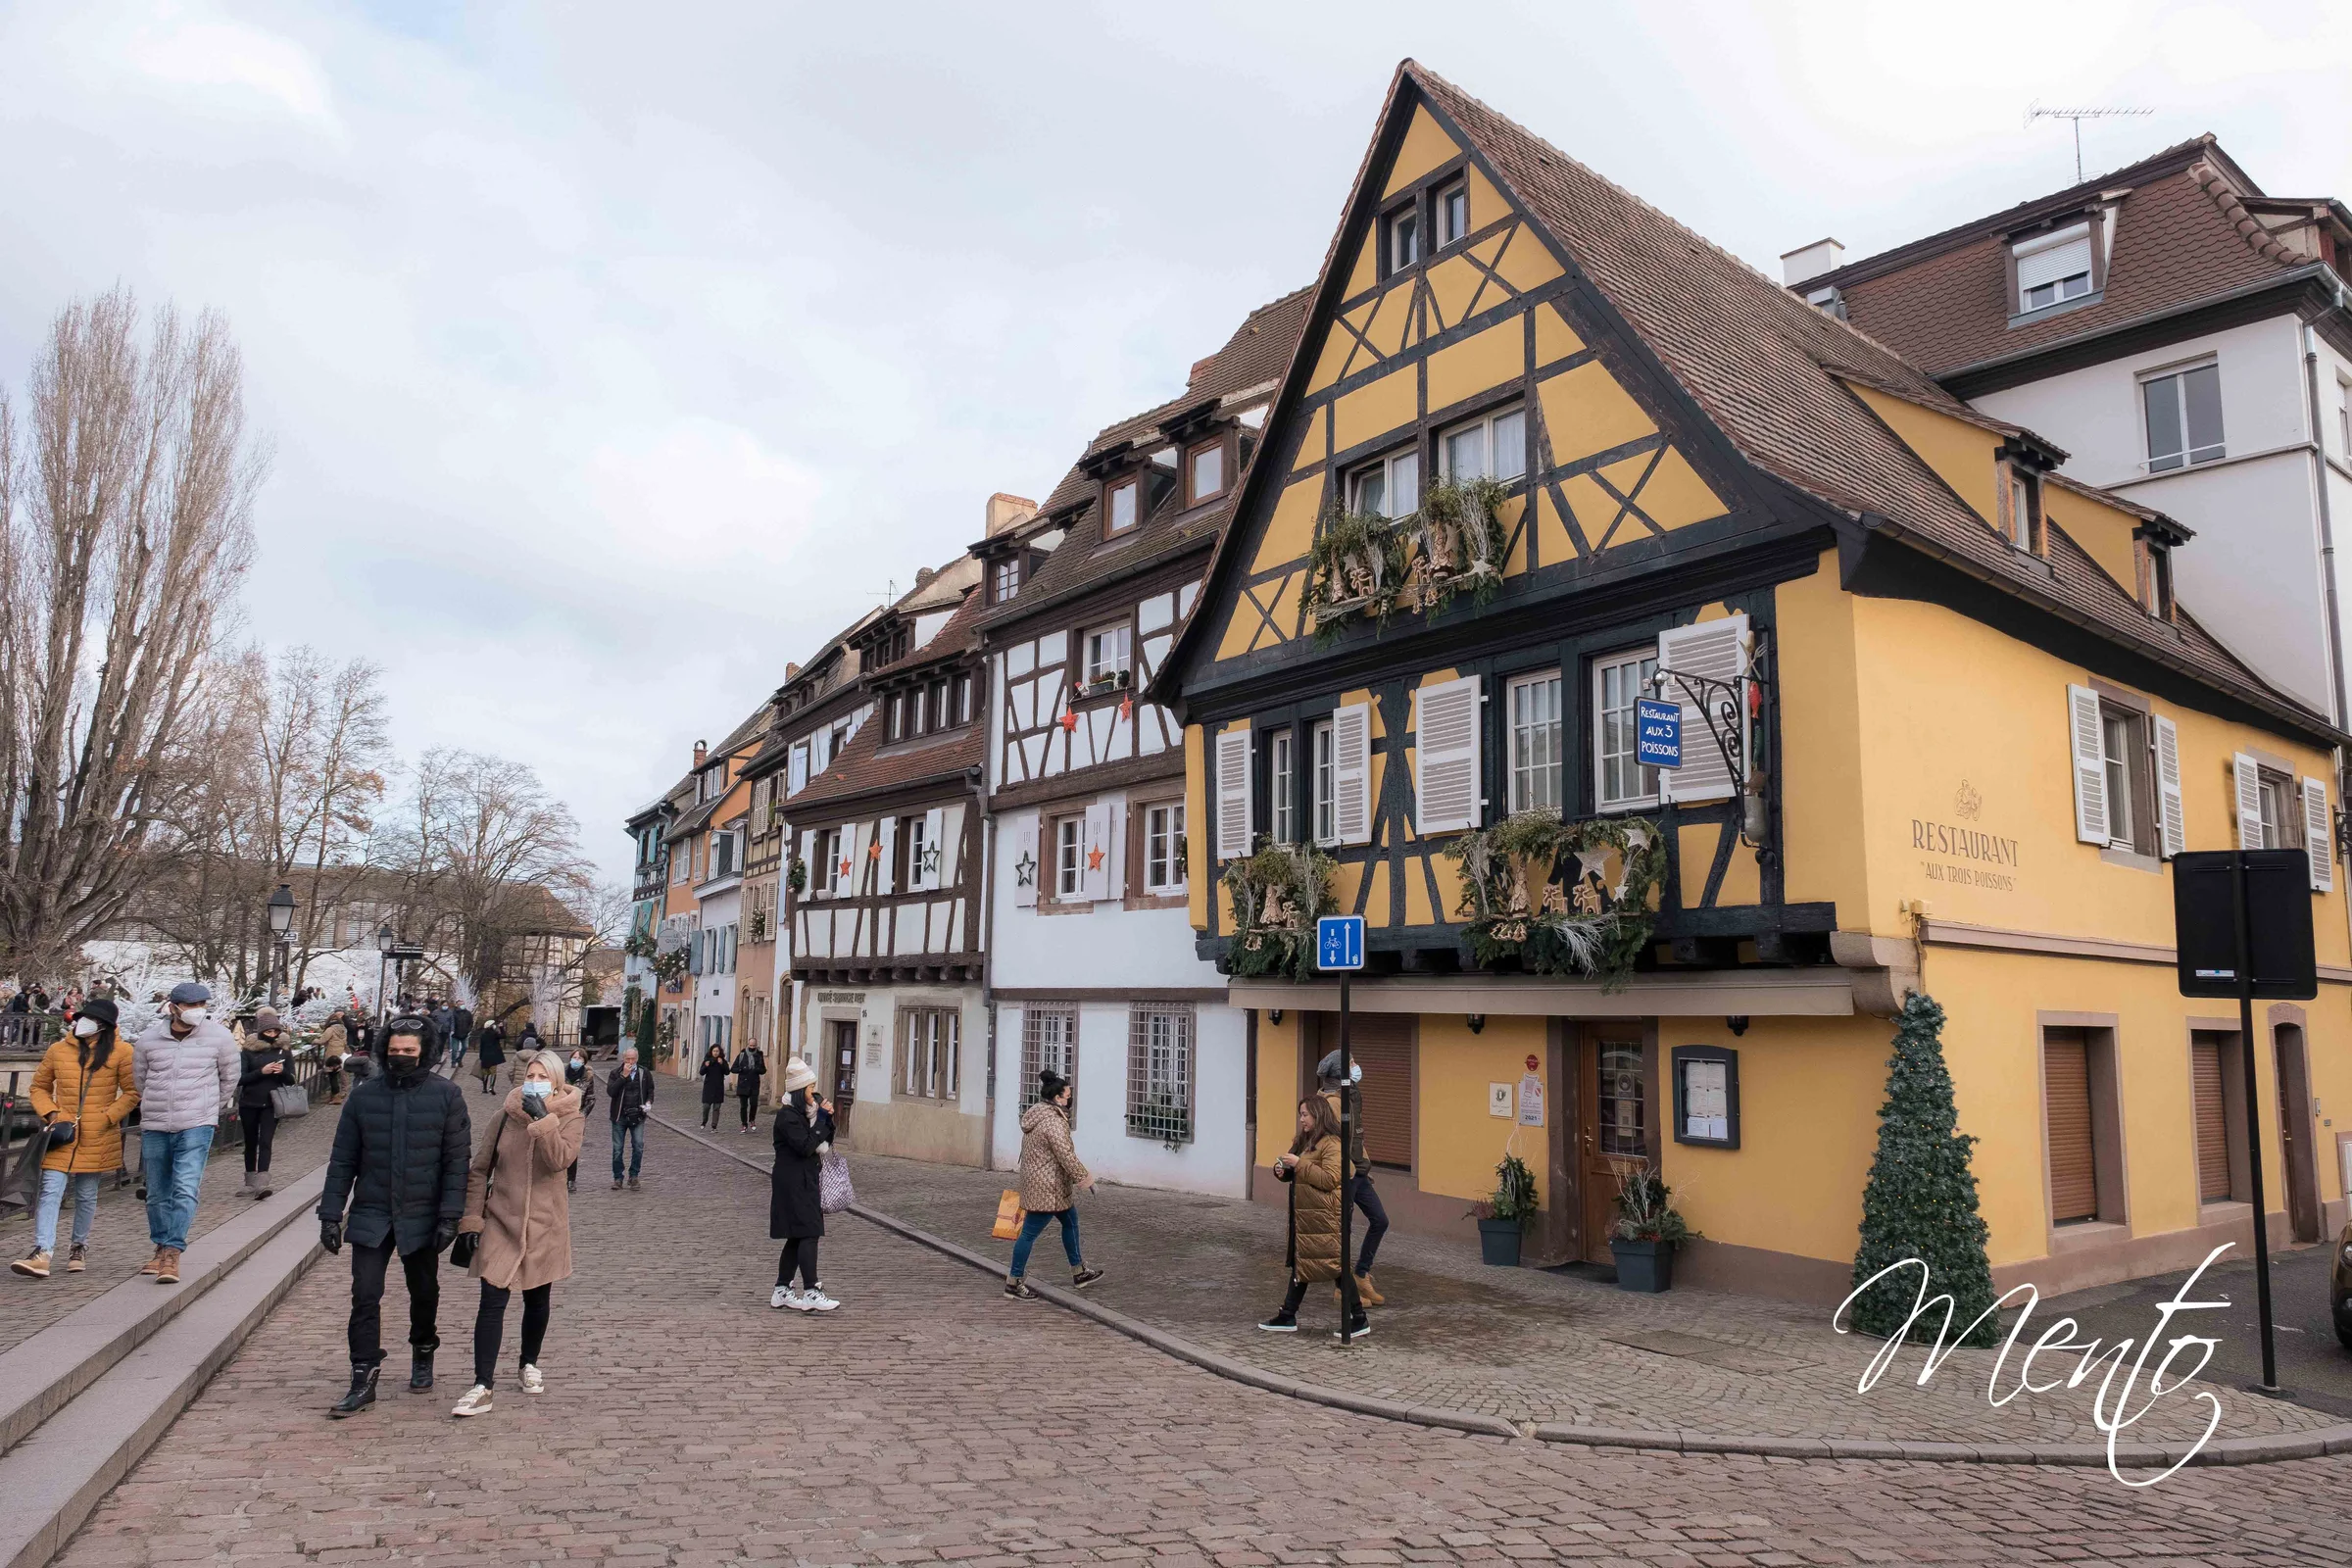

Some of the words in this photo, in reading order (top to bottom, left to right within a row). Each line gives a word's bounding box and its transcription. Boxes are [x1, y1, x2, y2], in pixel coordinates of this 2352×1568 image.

[1641, 707, 1680, 722] RESTAURANT
[1645, 725, 1664, 737] AUX
[1664, 724, 1674, 738] 3
[1911, 818, 2019, 867] RESTAURANT
[1946, 865, 1973, 885] TROIS
